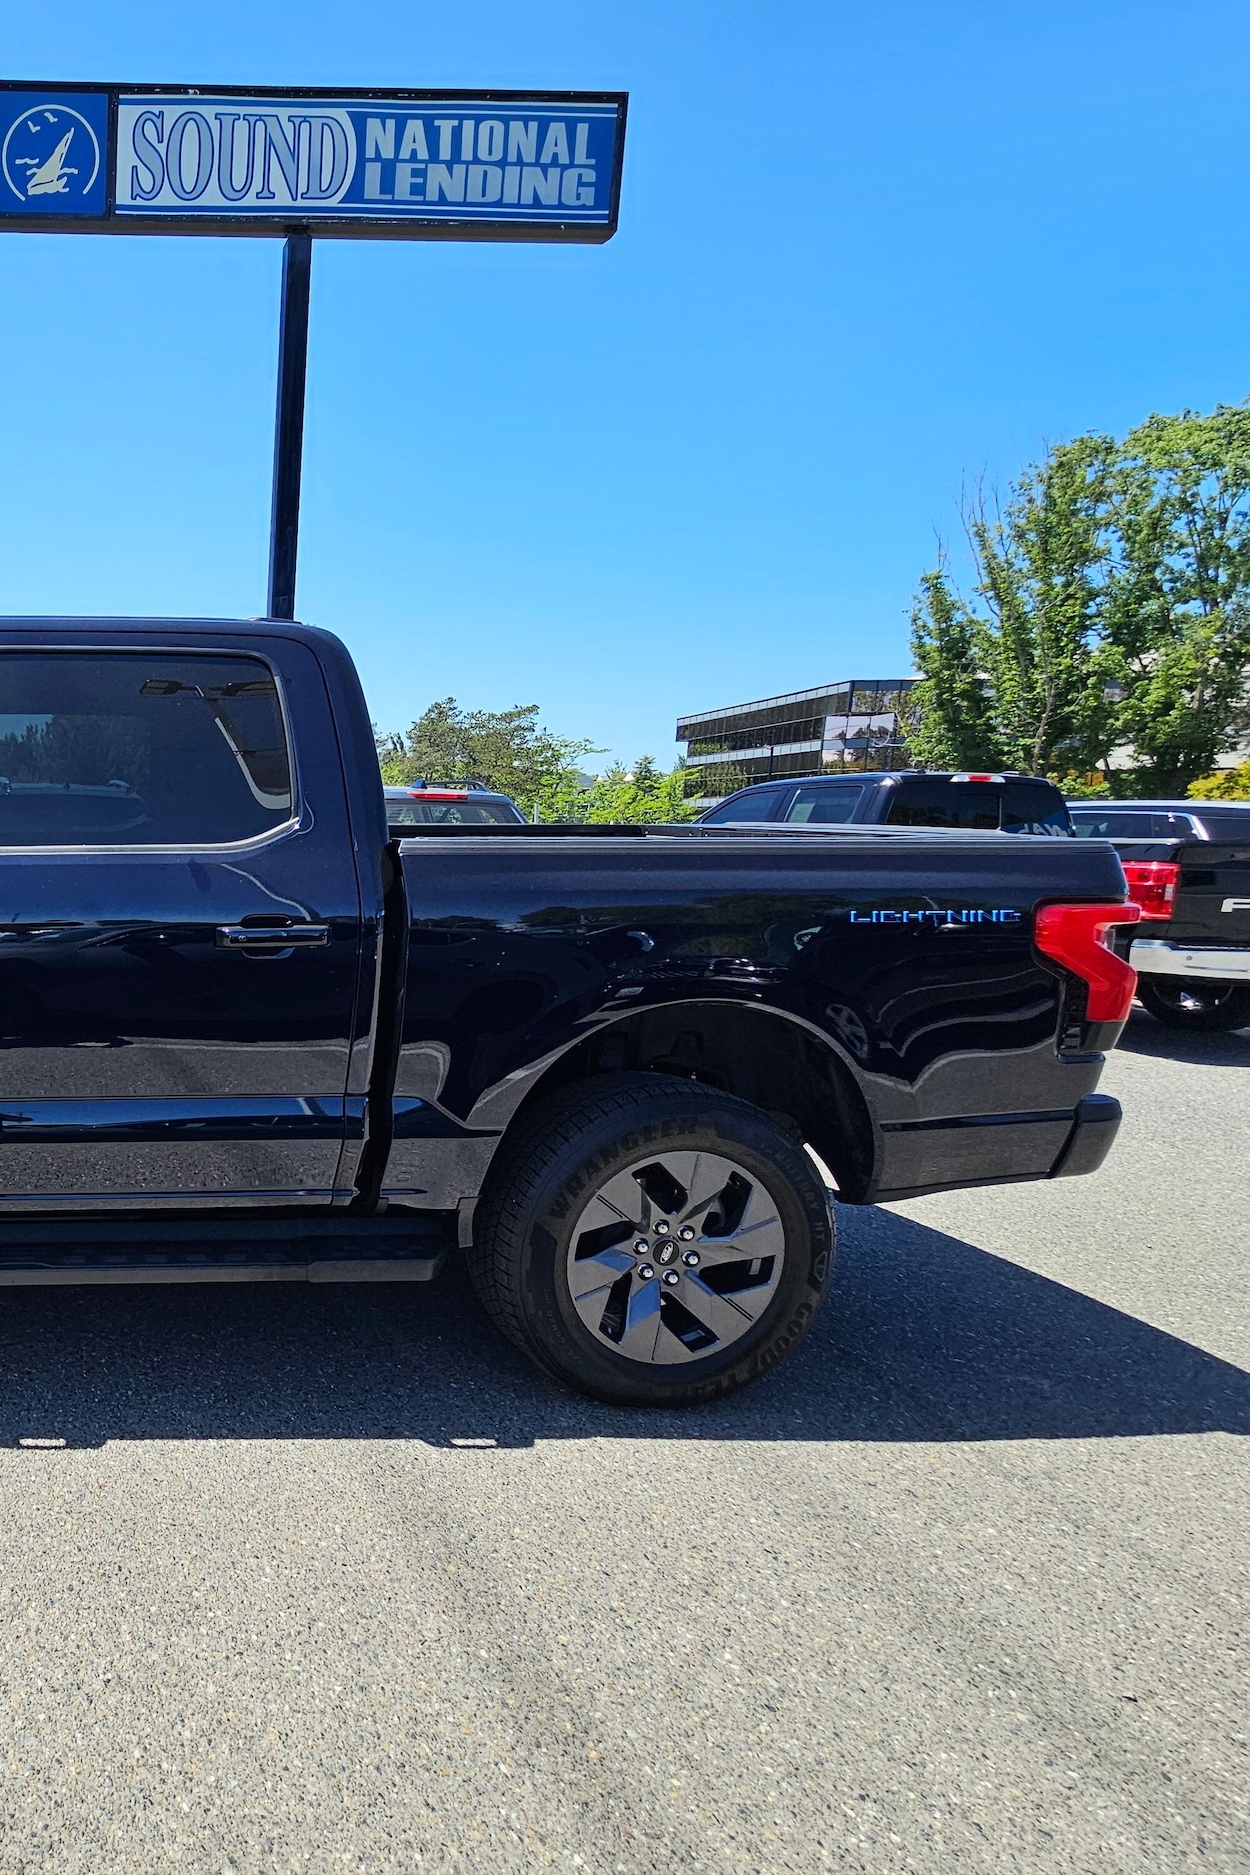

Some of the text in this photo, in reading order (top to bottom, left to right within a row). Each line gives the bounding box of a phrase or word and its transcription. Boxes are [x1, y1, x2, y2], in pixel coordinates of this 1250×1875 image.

[130, 110, 350, 202] SOUND
[364, 117, 596, 165] NATIONAL
[363, 162, 596, 206] LENDING
[850, 910, 1021, 927] LIGHTNING
[547, 1114, 700, 1220] WRANGLER
